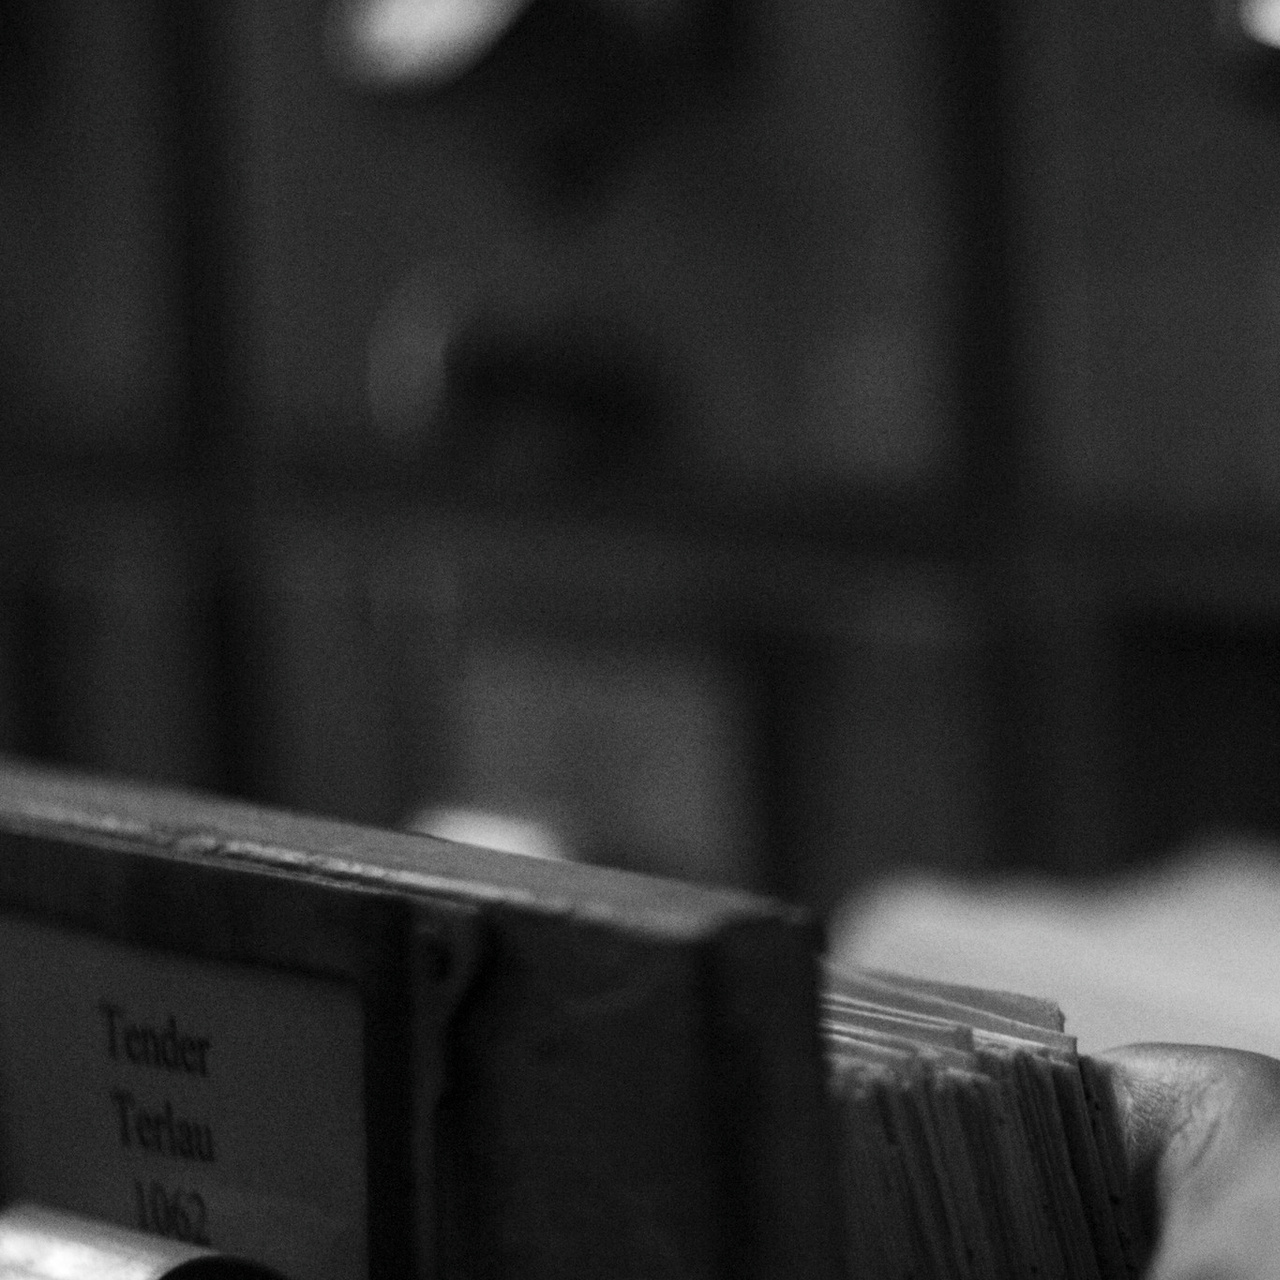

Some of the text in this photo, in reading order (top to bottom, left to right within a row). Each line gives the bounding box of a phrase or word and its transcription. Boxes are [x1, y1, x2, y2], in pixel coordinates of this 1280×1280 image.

[99, 1001, 211, 1077] Tender
[112, 1087, 214, 1162] Terlau
[134, 1178, 211, 1247] 1062
